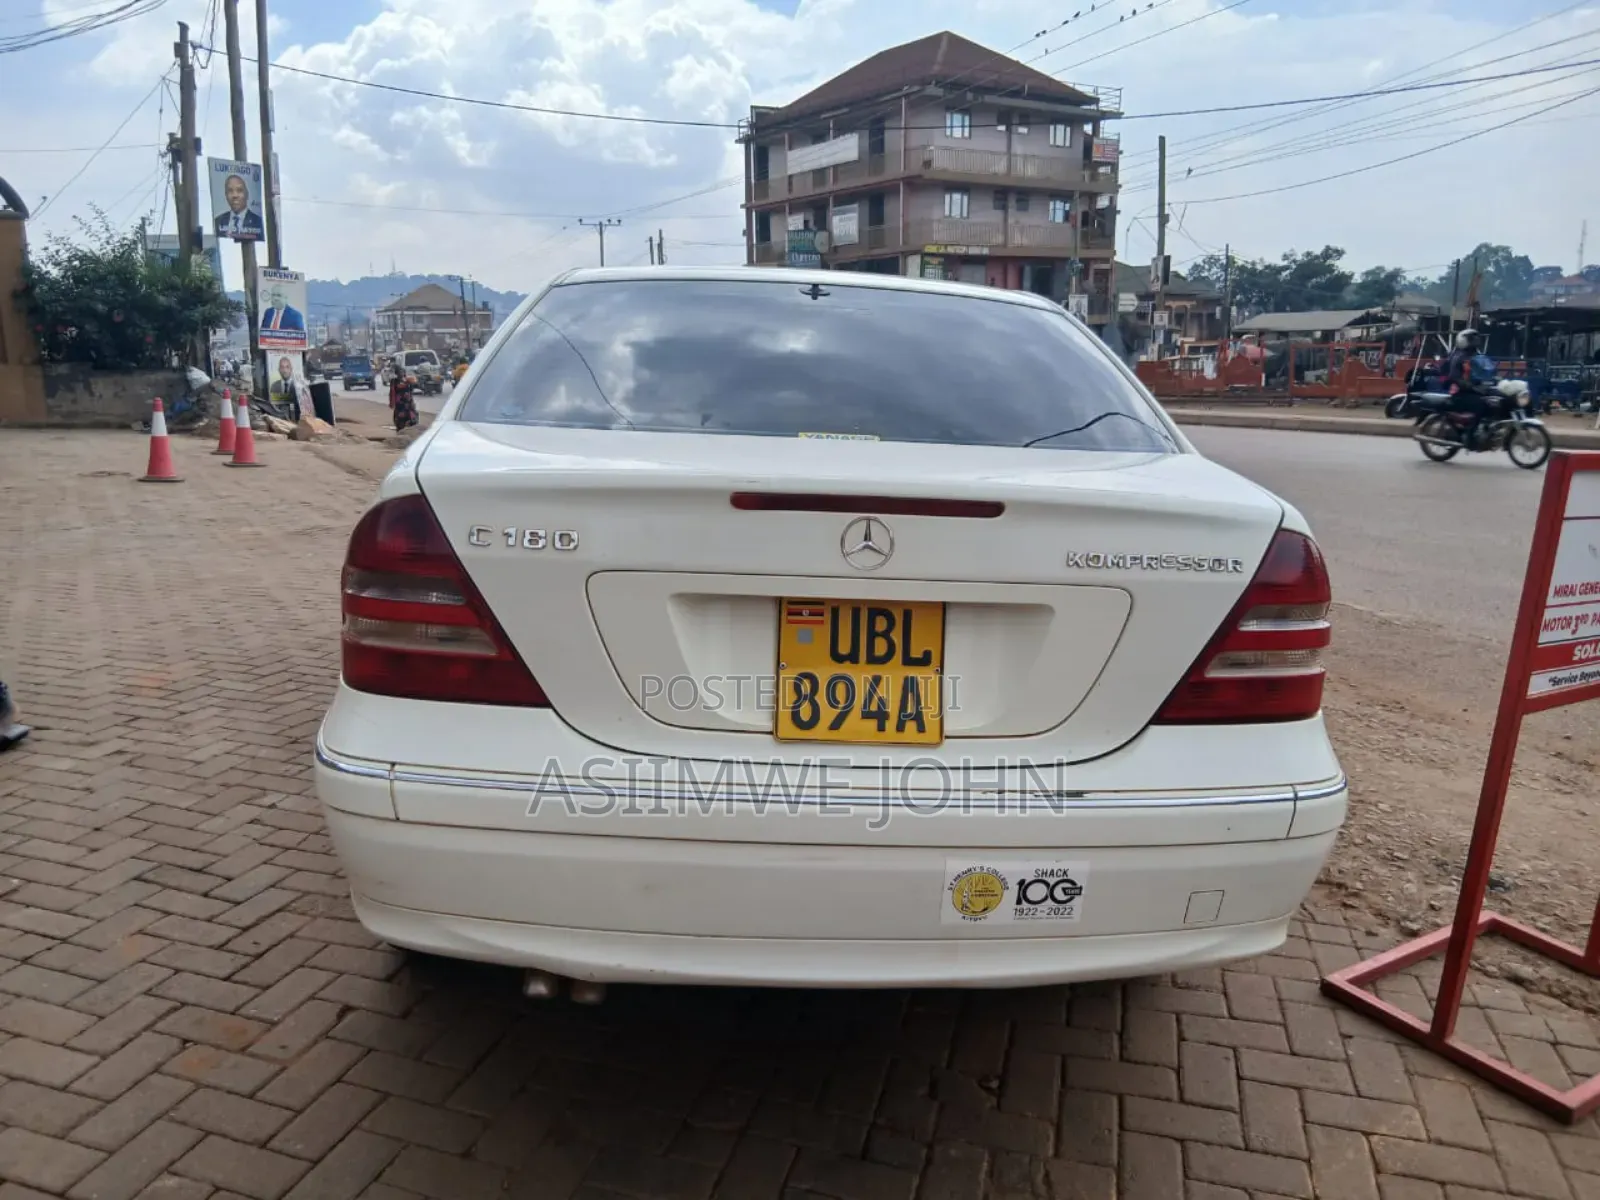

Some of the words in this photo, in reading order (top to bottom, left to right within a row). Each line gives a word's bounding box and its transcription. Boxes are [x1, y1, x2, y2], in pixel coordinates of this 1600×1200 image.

[263, 270, 300, 280] BUKENYA
[1066, 550, 1244, 573] KOMPRESSOR
[1553, 584, 1578, 598] MIRAI
[1542, 616, 1572, 632] MOTOR
[829, 605, 932, 667] UBL
[790, 672, 927, 733] 894A
[1033, 867, 1070, 878] SHACK
[1015, 878, 1078, 906] 100
